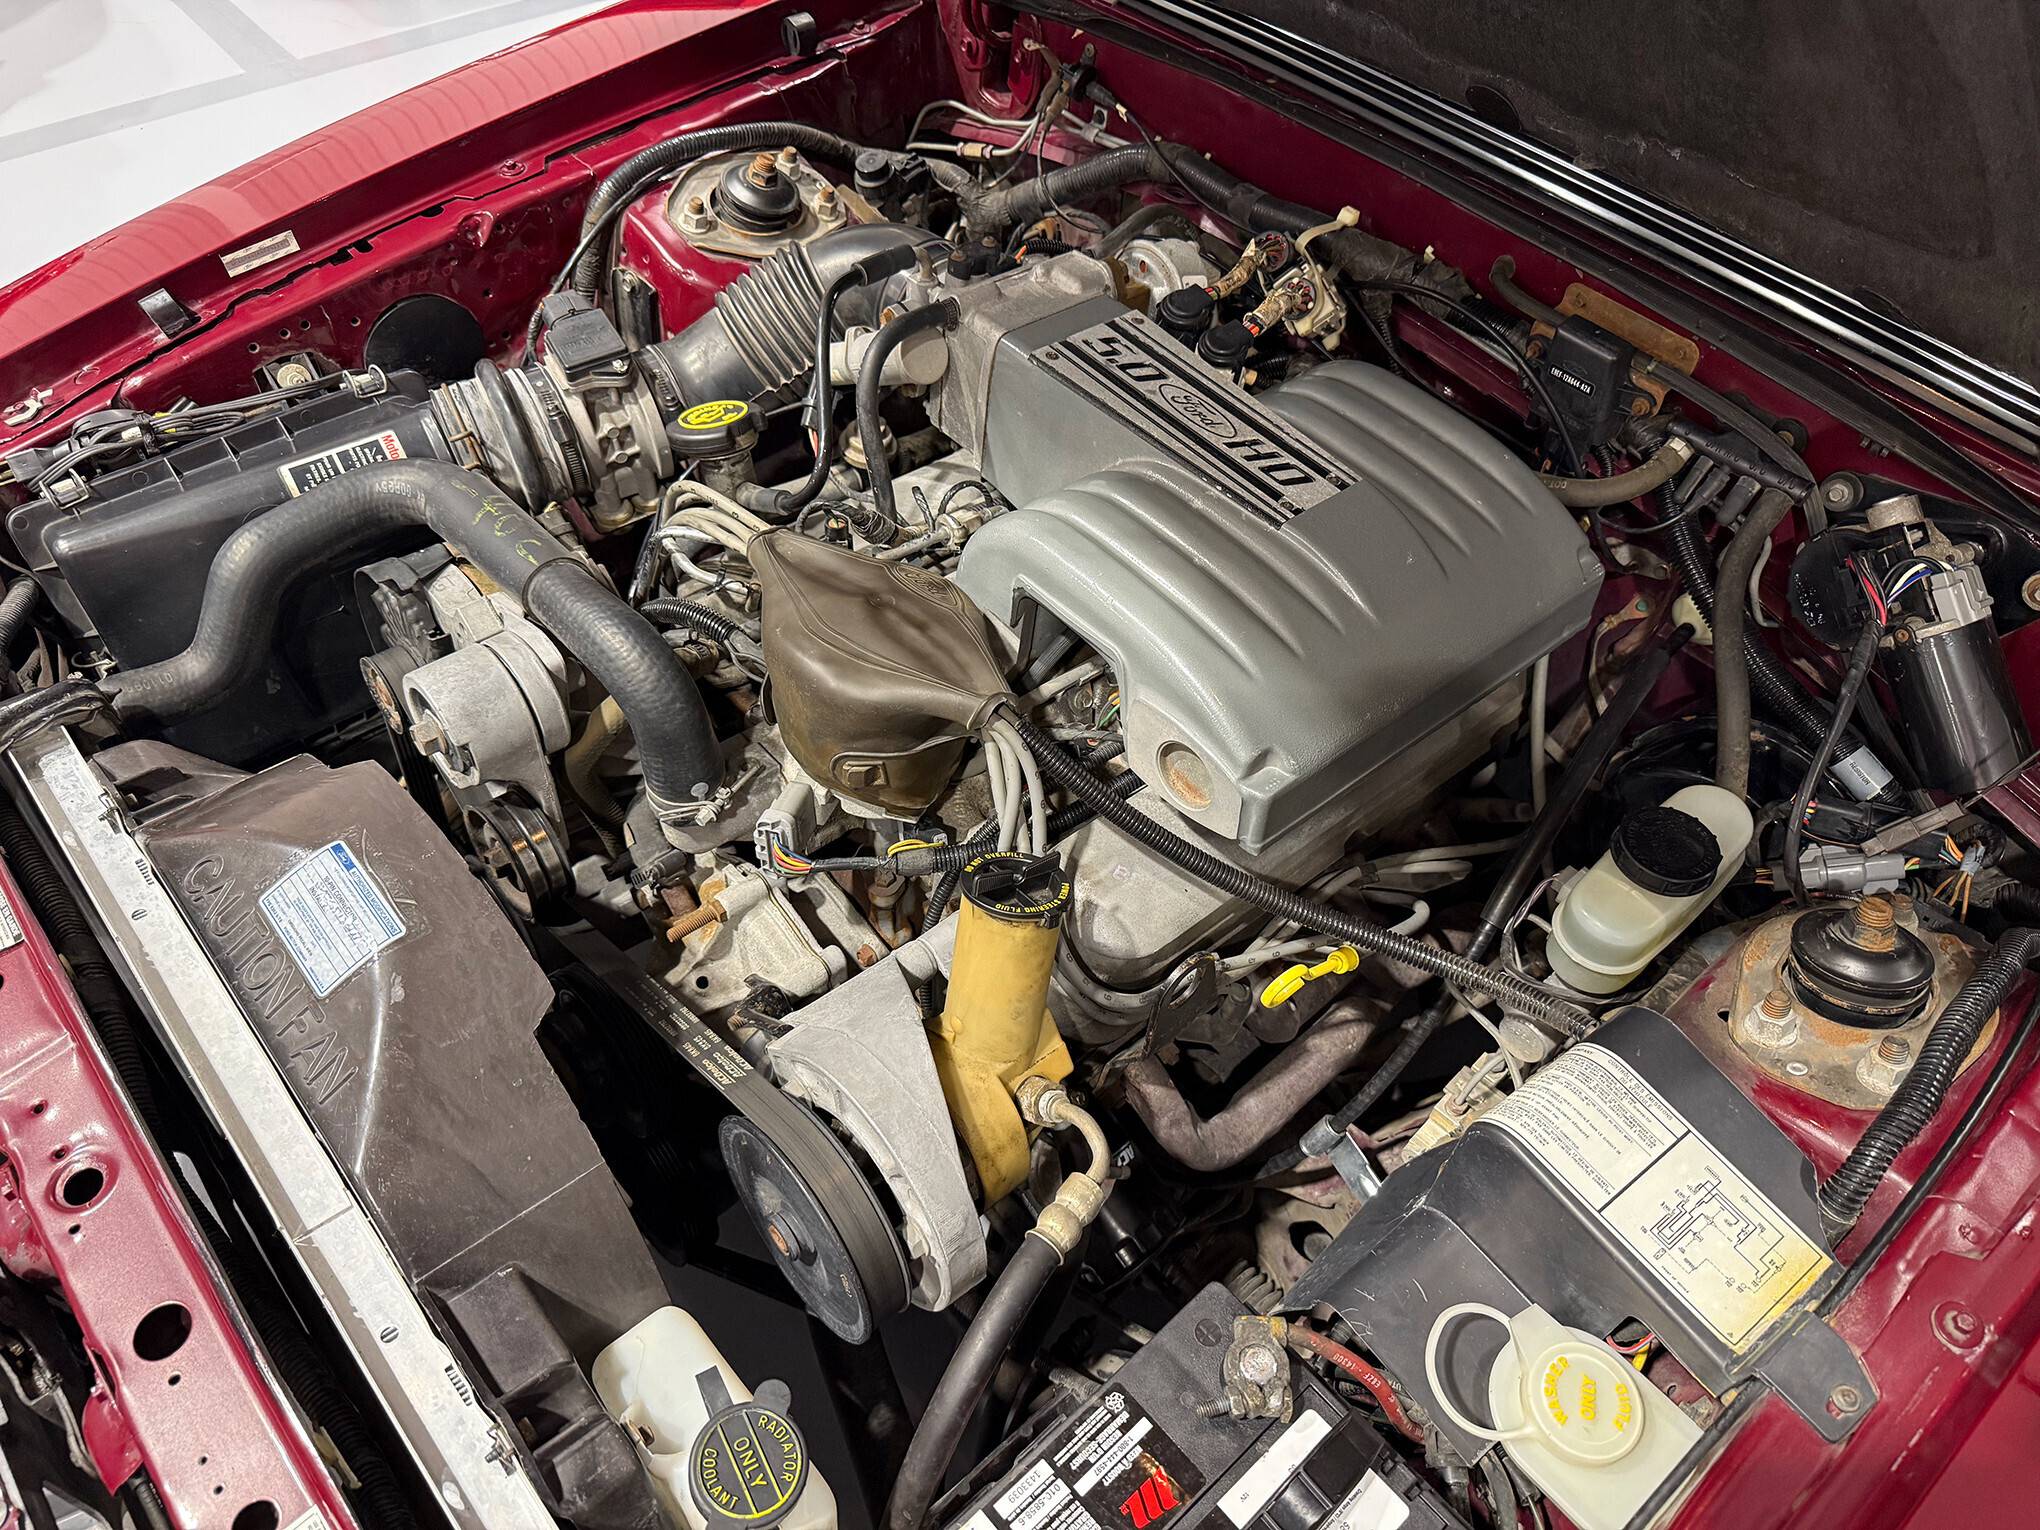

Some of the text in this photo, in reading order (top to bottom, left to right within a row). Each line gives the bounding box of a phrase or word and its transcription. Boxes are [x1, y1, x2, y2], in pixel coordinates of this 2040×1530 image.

[1080, 334, 1163, 383] 5.0
[995, 903, 1020, 912] FLUID
[1024, 898, 1059, 912] STEERING
[185, 854, 306, 1020] CAUTION
[275, 1001, 359, 1105] FAN
[1543, 1355, 1568, 1423] WASHER
[1583, 1374, 1595, 1419] ONLY
[1614, 1383, 1631, 1431] FLUID
[734, 1438, 767, 1485] ONLY
[758, 1414, 797, 1481] RADIATOR
[700, 1449, 740, 1510] COOLANT
[1006, 1470, 1040, 1503] 1433039
